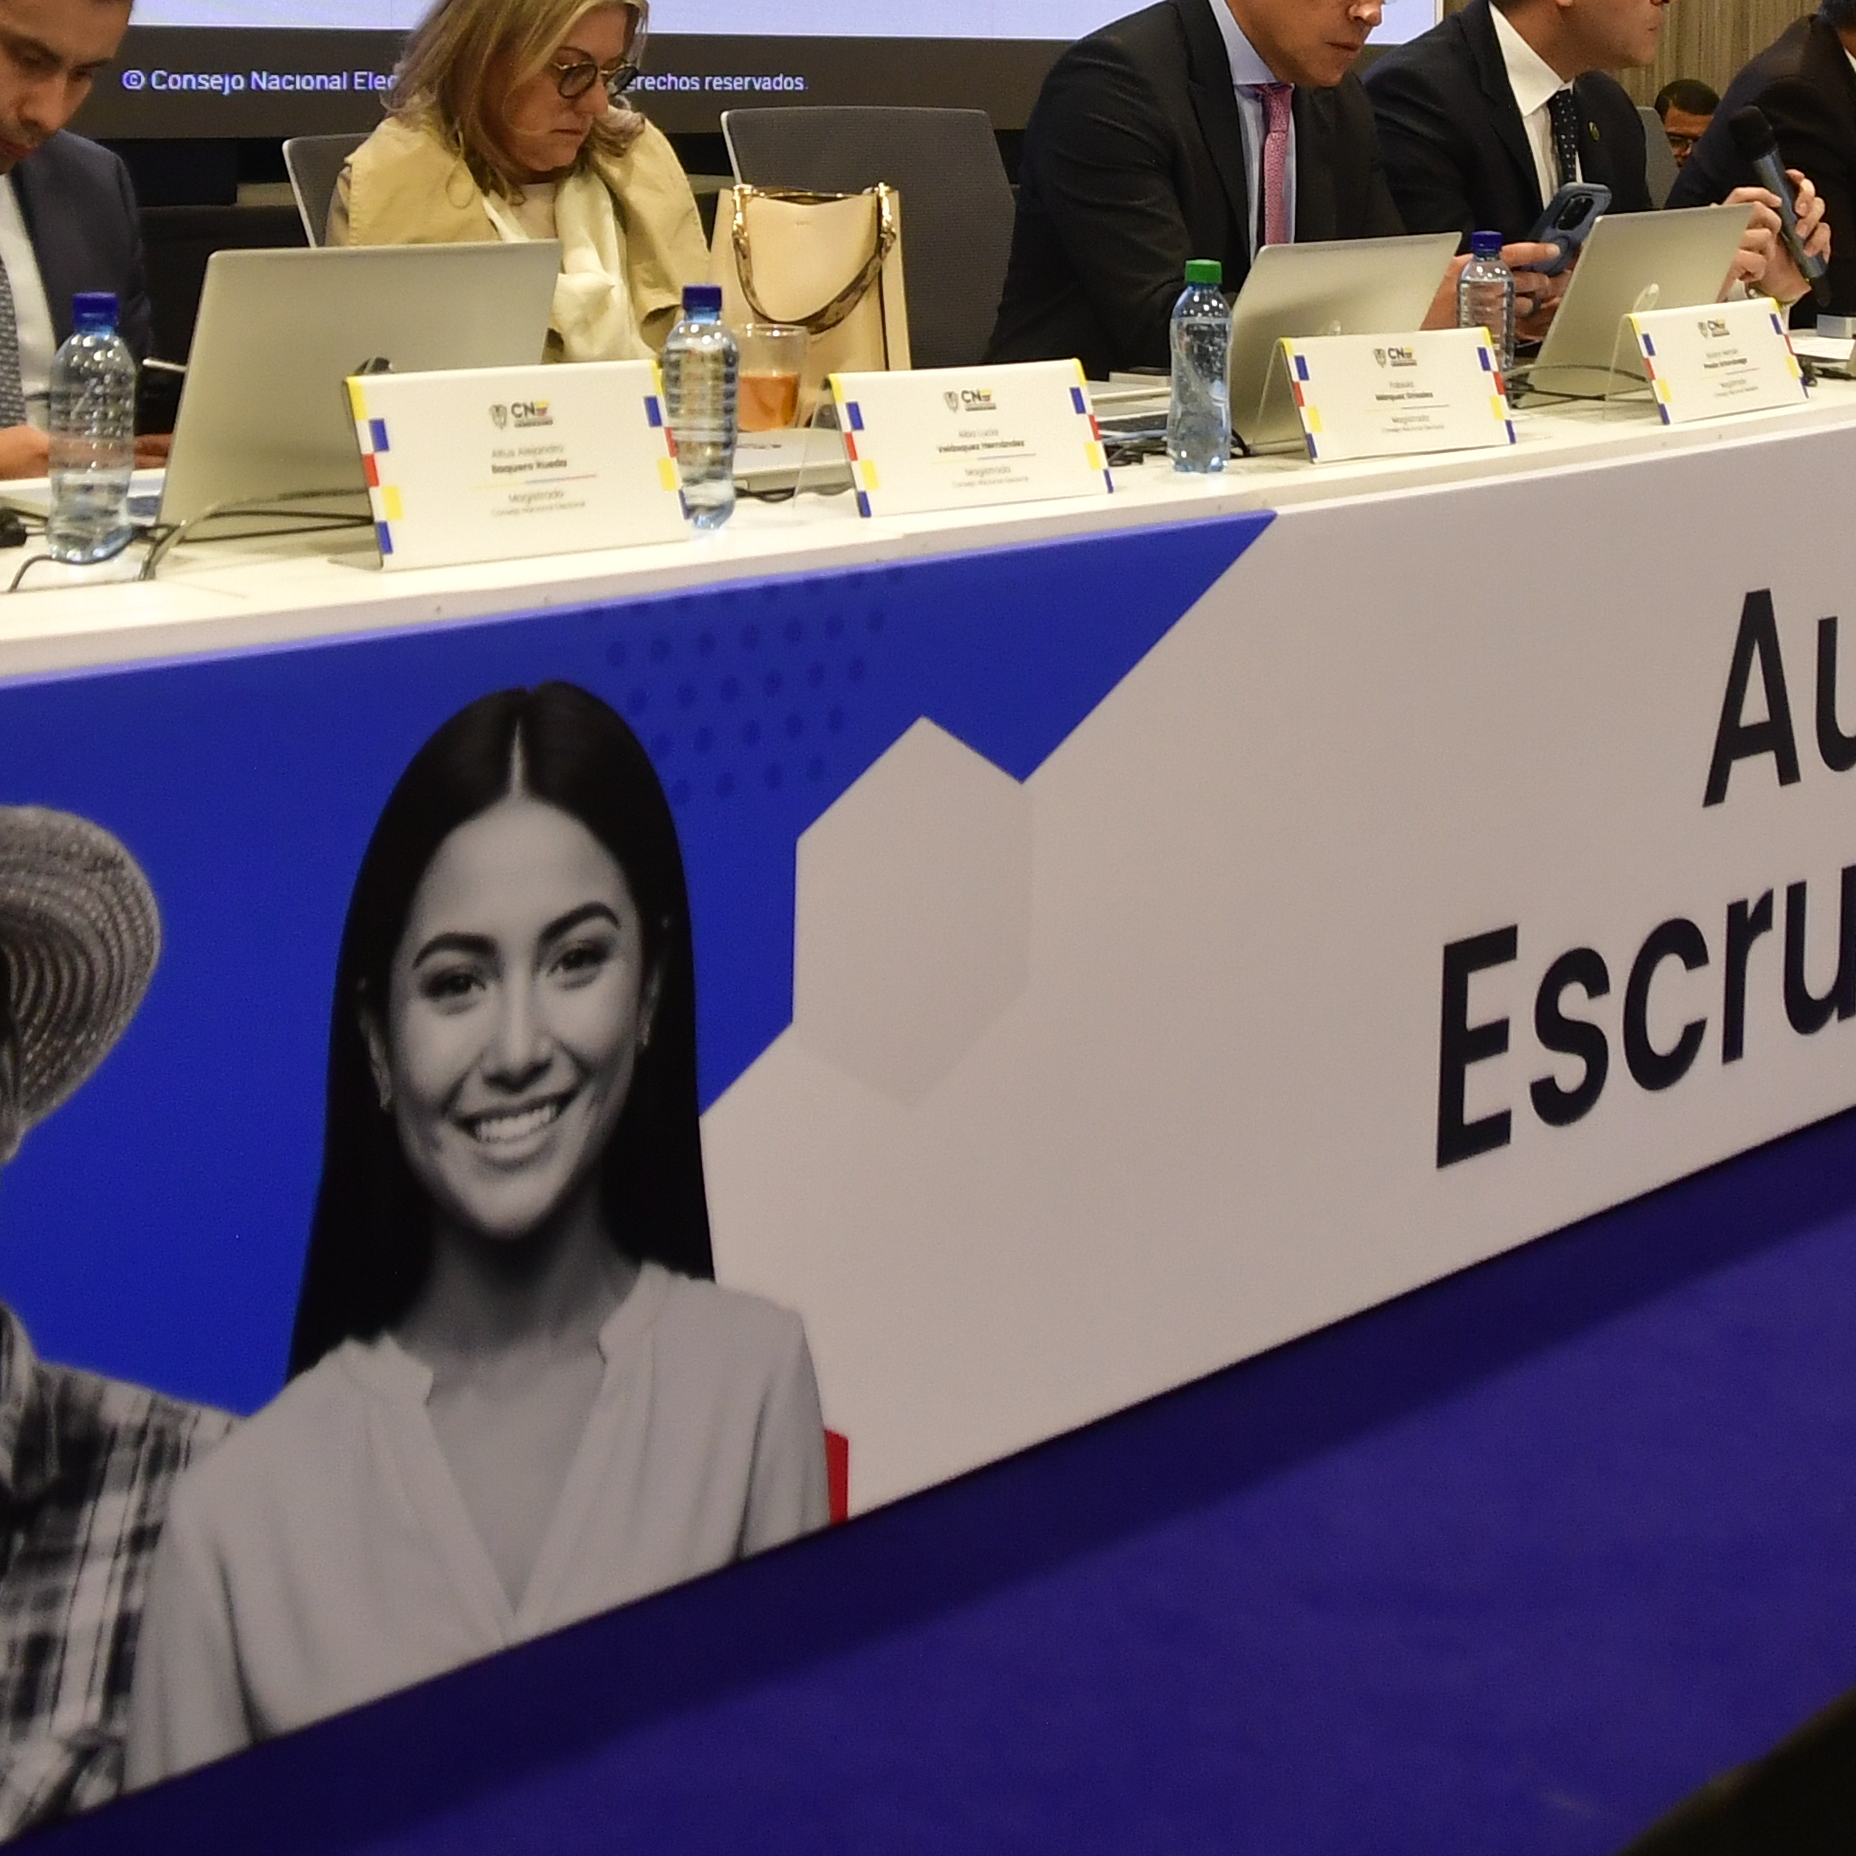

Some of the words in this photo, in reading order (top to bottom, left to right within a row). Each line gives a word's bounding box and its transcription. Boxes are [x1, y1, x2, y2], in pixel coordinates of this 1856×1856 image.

[150, 69, 245, 95] Consejo
[250, 70, 348, 92] Nacional
[353, 70, 400, 92] Elec
